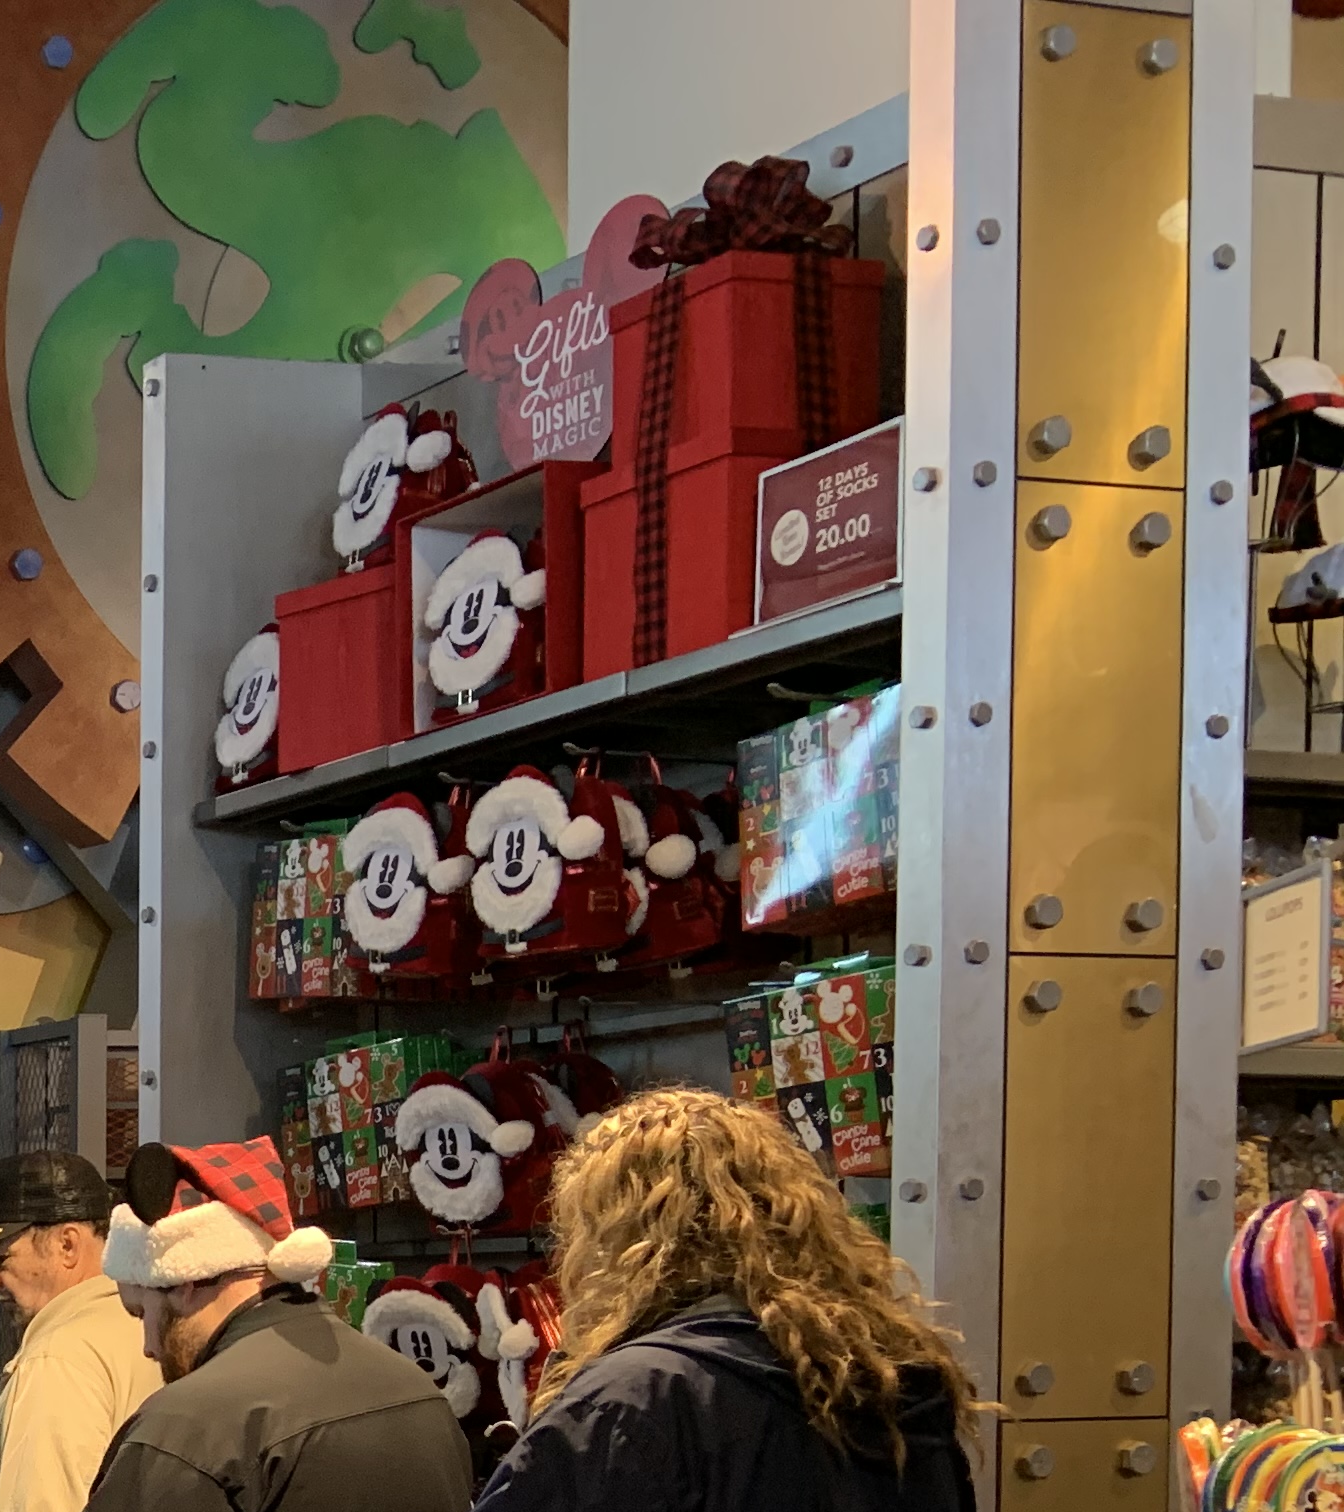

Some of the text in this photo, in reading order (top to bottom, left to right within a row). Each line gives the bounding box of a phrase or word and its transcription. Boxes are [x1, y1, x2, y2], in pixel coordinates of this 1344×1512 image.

[514, 292, 609, 419] Gifts
[549, 369, 595, 400] WITH
[532, 384, 604, 440] DISNEY
[533, 417, 601, 460] MAGIC
[816, 473, 879, 508] OF SOCKS
[818, 462, 869, 492] 12 DAYS
[816, 503, 838, 523] SET
[816, 513, 871, 554] 20.00
[874, 1047, 888, 1068] 3
[830, 1104, 844, 1123] 6
